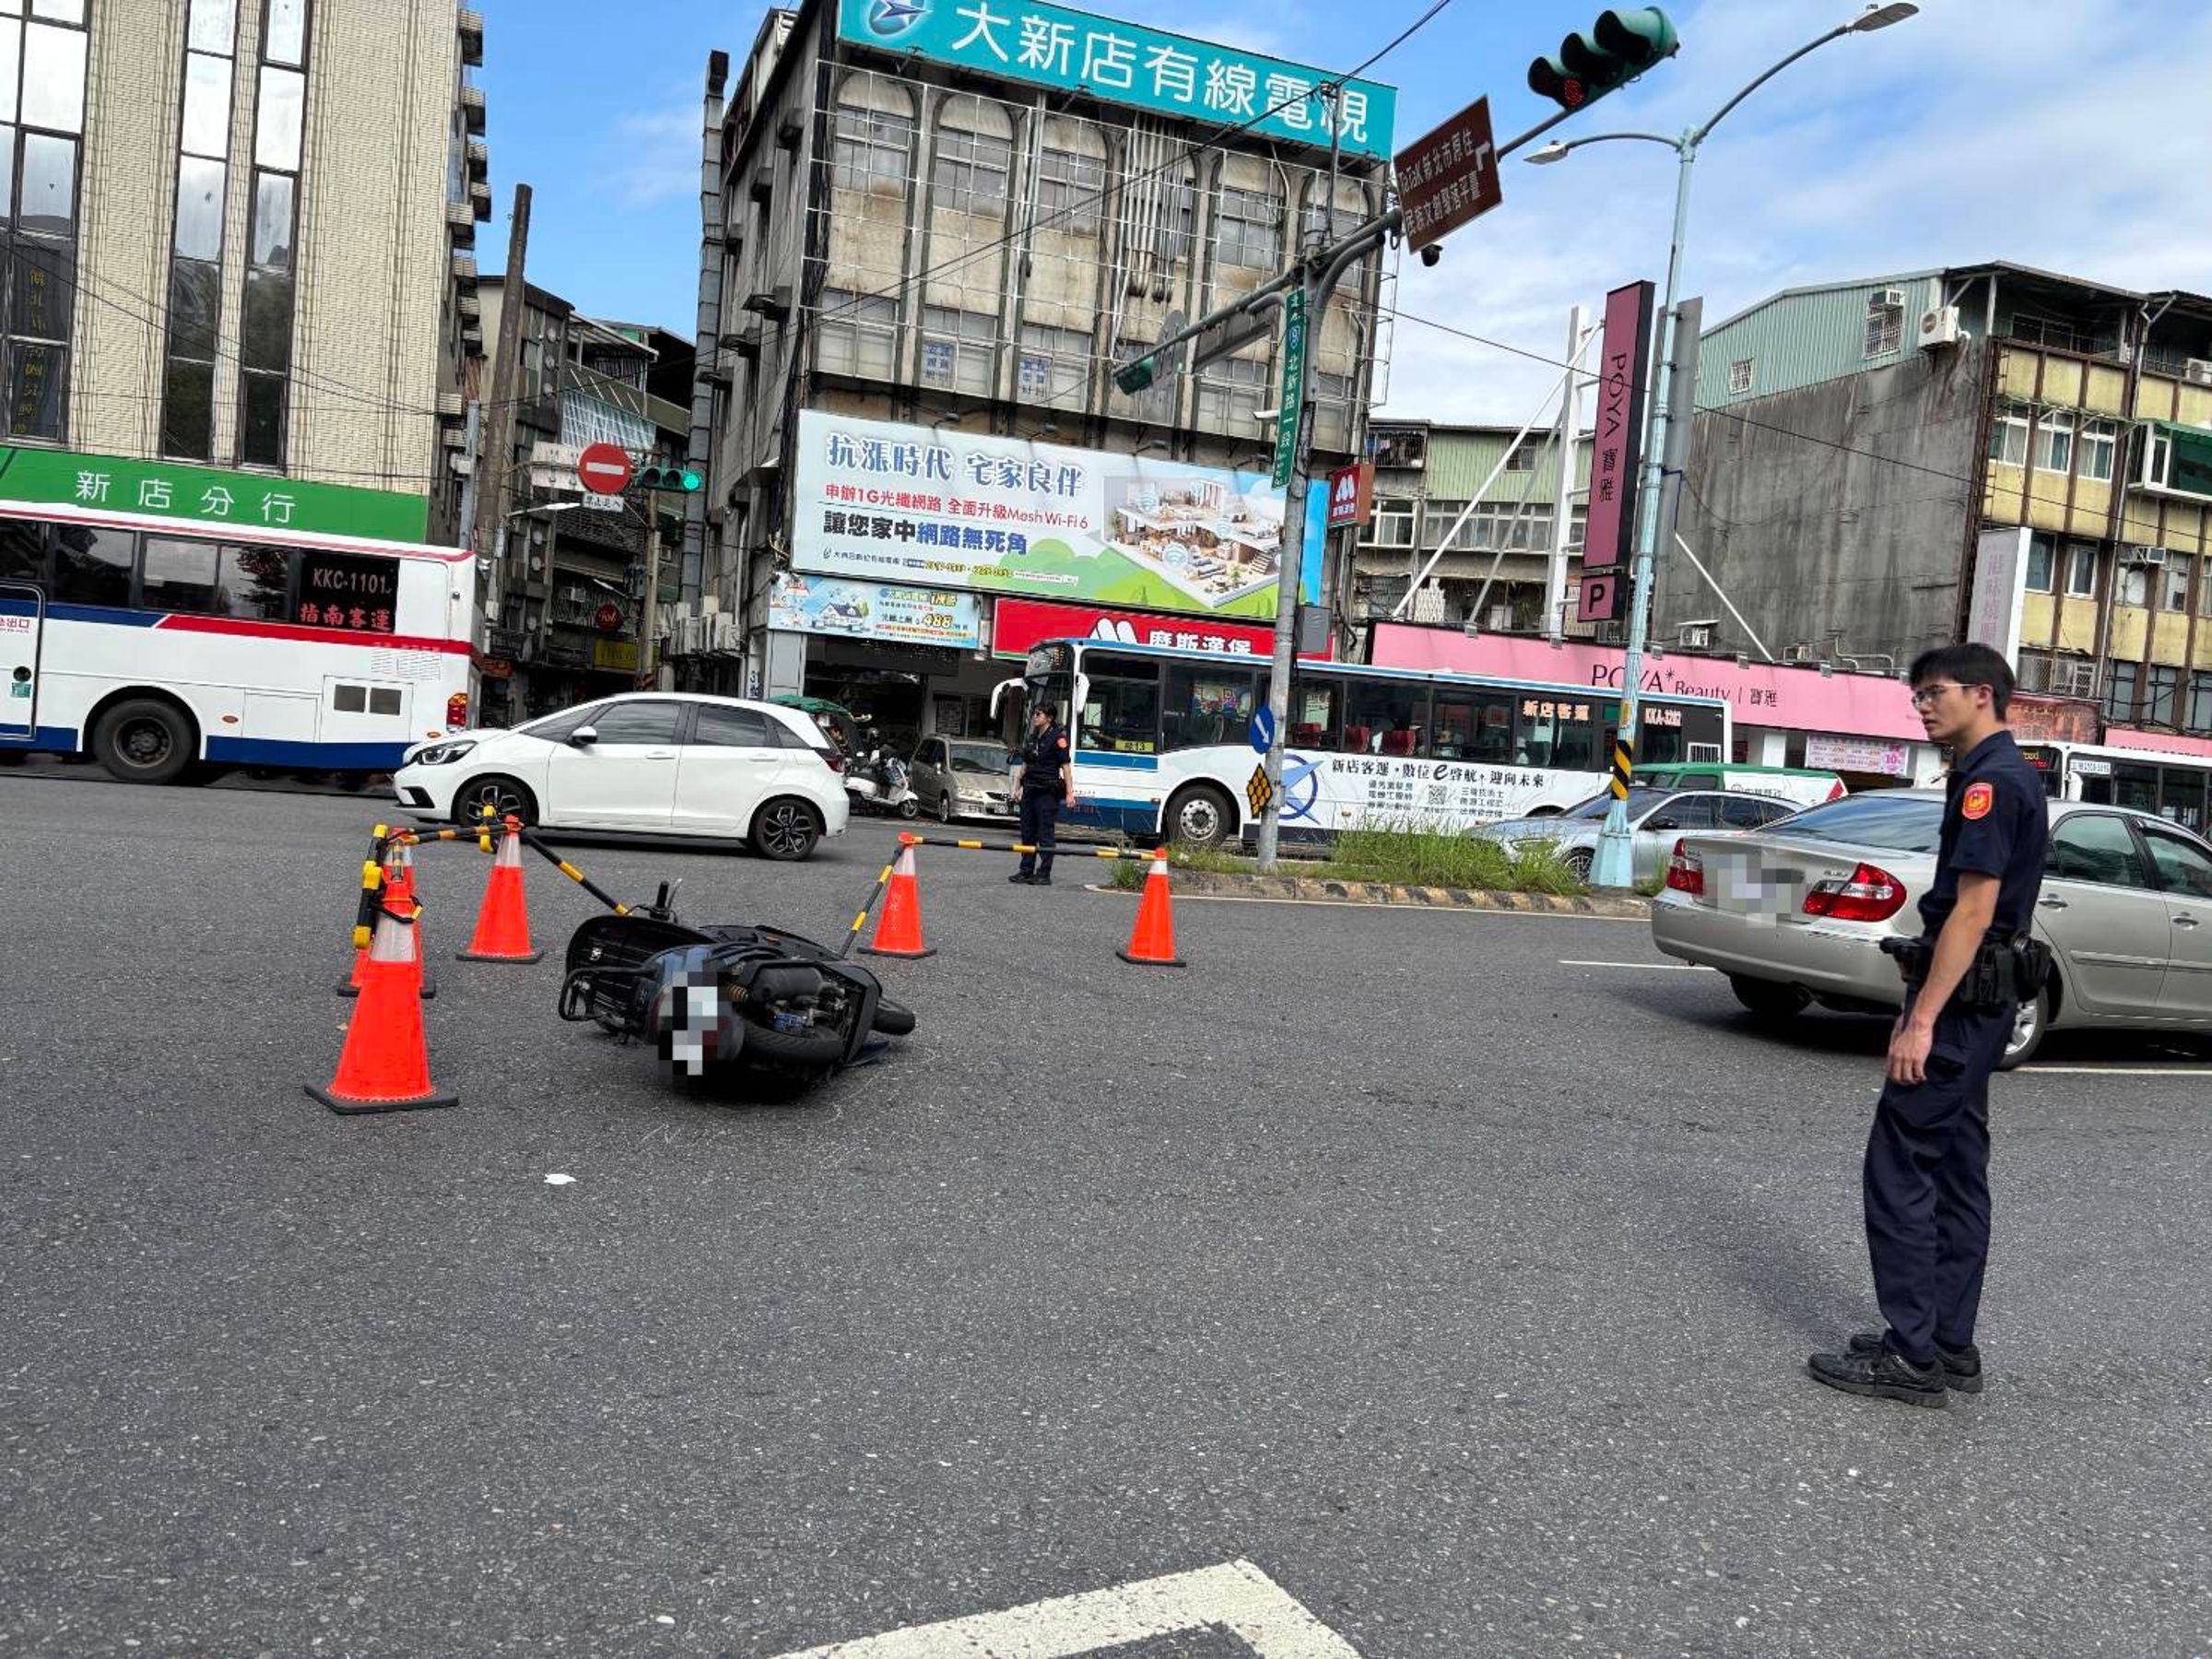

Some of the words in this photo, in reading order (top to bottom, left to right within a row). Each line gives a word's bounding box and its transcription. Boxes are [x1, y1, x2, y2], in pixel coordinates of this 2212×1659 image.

[952, 1, 1368, 144] 大新店有線電視
[1605, 353, 1628, 439] POYA
[827, 433, 953, 481] 抗漲時代
[966, 454, 1083, 498] 宅家良伴
[76, 470, 296, 524] 新店分行
[823, 511, 1027, 555] 讓您家中網路無死角
[312, 568, 386, 594] KKC-1101
[1589, 583, 1606, 613] P
[300, 603, 392, 631] 指南客運
[923, 614, 953, 629] 488
[1676, 680, 1731, 700] Beauty
